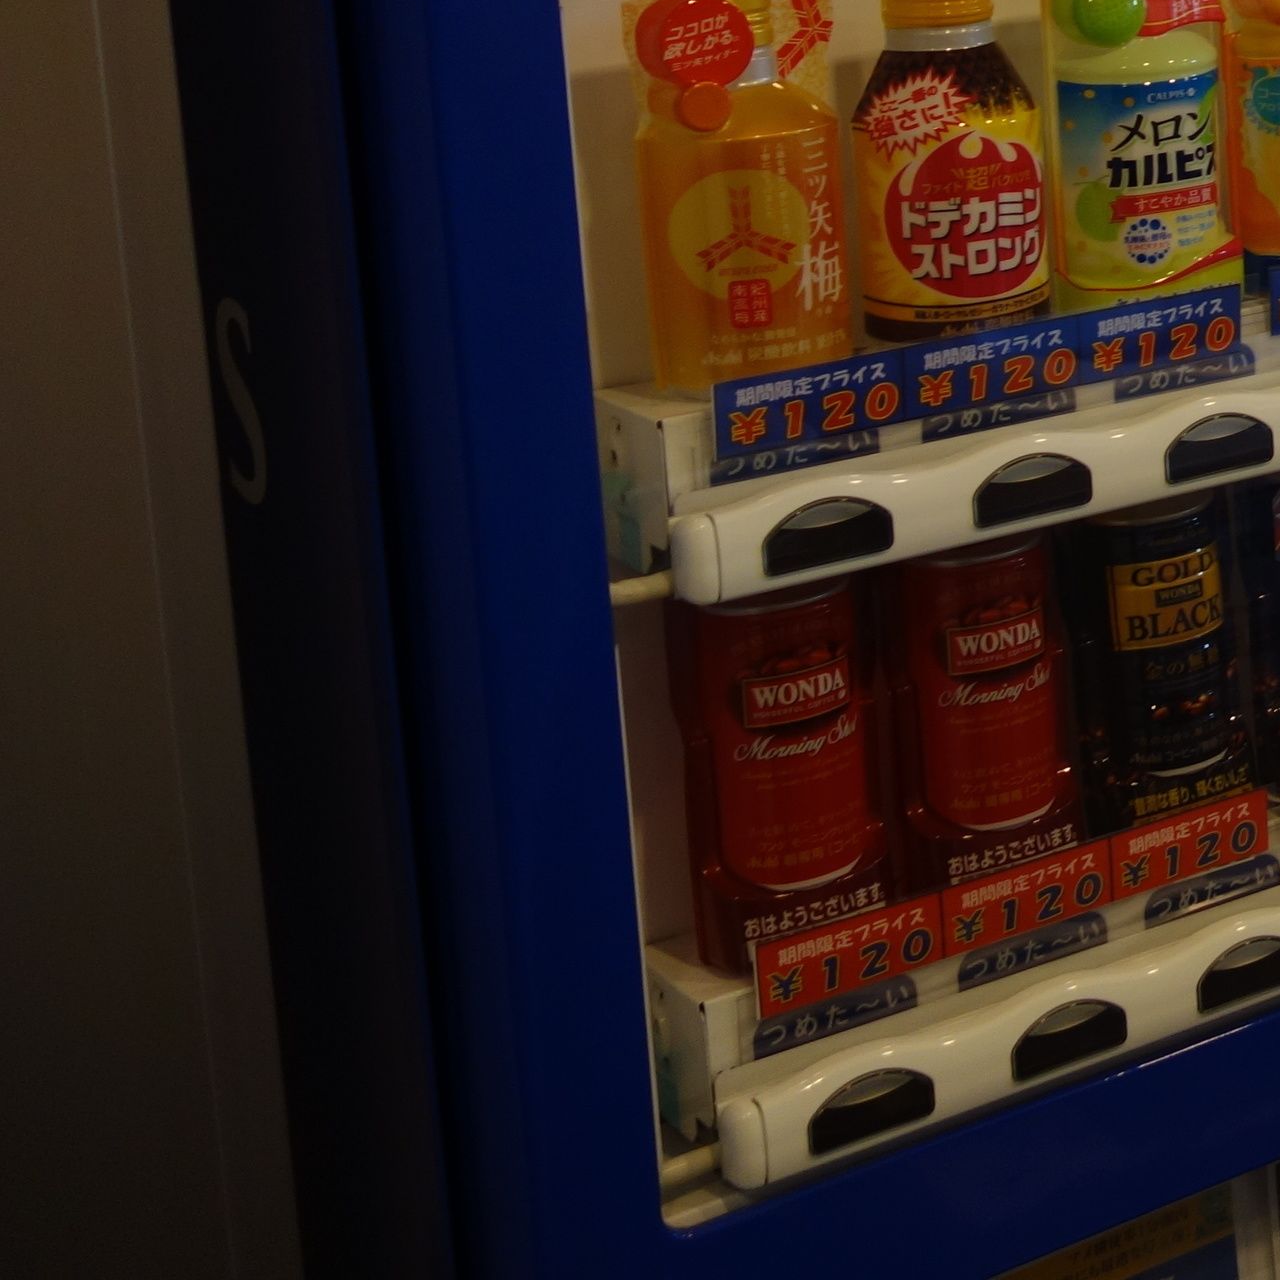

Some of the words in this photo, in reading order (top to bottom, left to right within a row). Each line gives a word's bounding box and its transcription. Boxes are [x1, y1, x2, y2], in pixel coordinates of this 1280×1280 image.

[663, 29, 735, 61] 欲しがる
[666, 12, 729, 41] ココロが
[1110, 113, 1212, 152] メロン
[901, 187, 1041, 240] ドデカミン
[1133, 187, 1212, 212] すこやか品質
[911, 223, 1041, 280] ストロング
[1093, 315, 1236, 373] ¥120
[917, 348, 1078, 407] ¥120
[728, 381, 900, 446] ¥120
[1131, 549, 1215, 588] GOLD
[956, 618, 1043, 659] WONDA
[1126, 592, 1222, 643] BLACK
[750, 669, 846, 711] WONDA
[1119, 820, 1258, 889] ¥120
[952, 870, 1105, 945] ¥120
[766, 926, 935, 1004] ¥120
